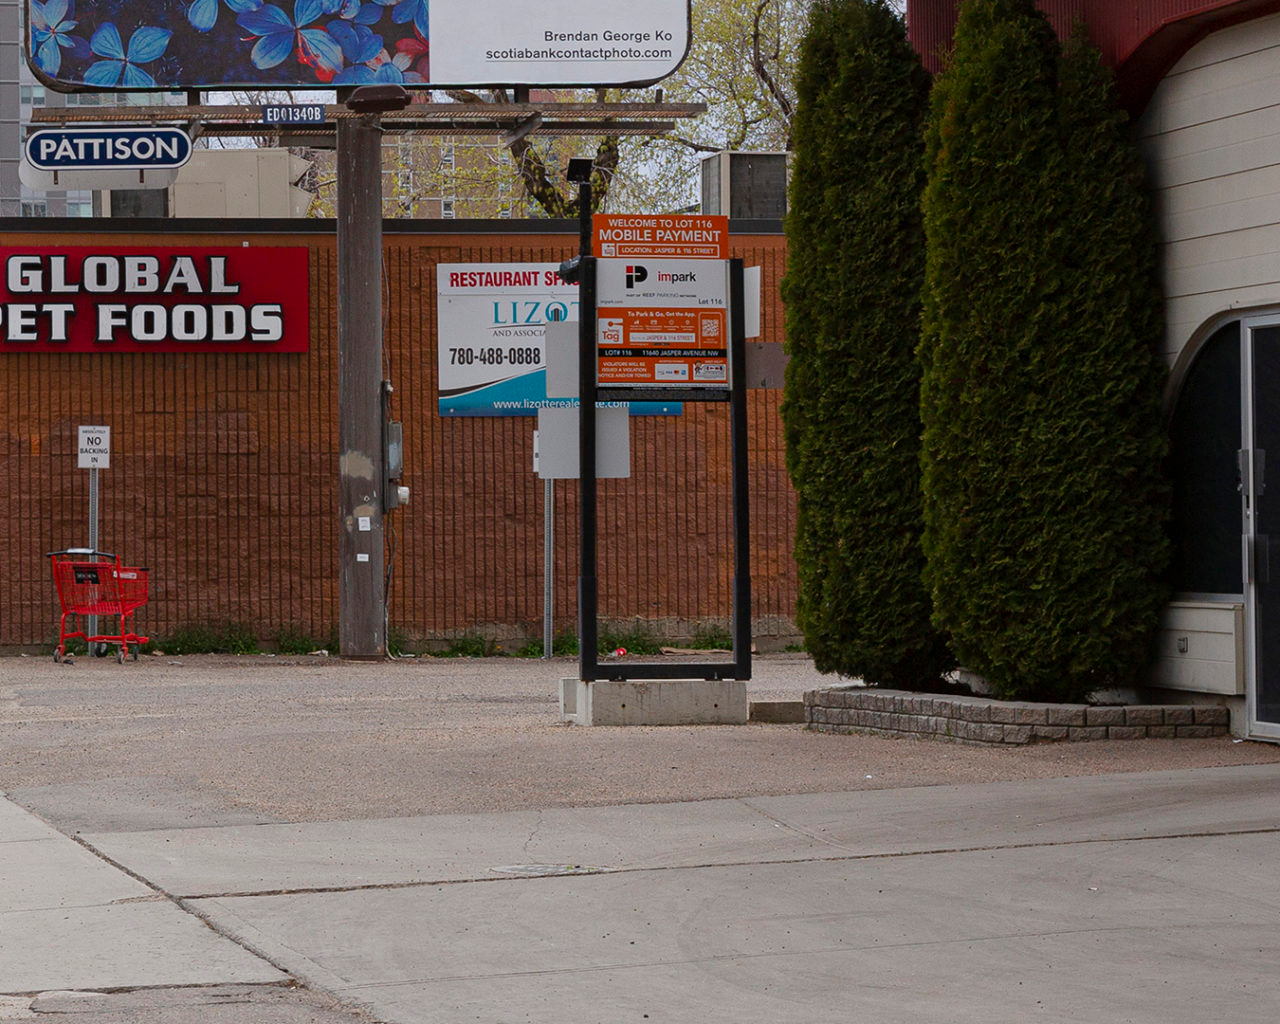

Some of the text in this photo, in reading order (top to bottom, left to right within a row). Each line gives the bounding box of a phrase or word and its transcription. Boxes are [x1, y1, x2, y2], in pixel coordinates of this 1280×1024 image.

[544, 31, 672, 43] Brendan George Ko
[486, 48, 672, 60] scotiabankcontactphoto.com
[39, 136, 178, 161] PATTISON
[608, 219, 712, 228] WELCOME TO LOT 116
[599, 229, 721, 242] MOBILE PAYMENT
[6, 255, 240, 294] GLOBAL
[449, 271, 540, 287] RESTAURANT
[657, 271, 697, 284] impark
[94, 302, 284, 343] FOODS
[602, 331, 620, 342] Tag
[449, 348, 541, 365] 780-488-0888
[87, 437, 102, 445] NO
